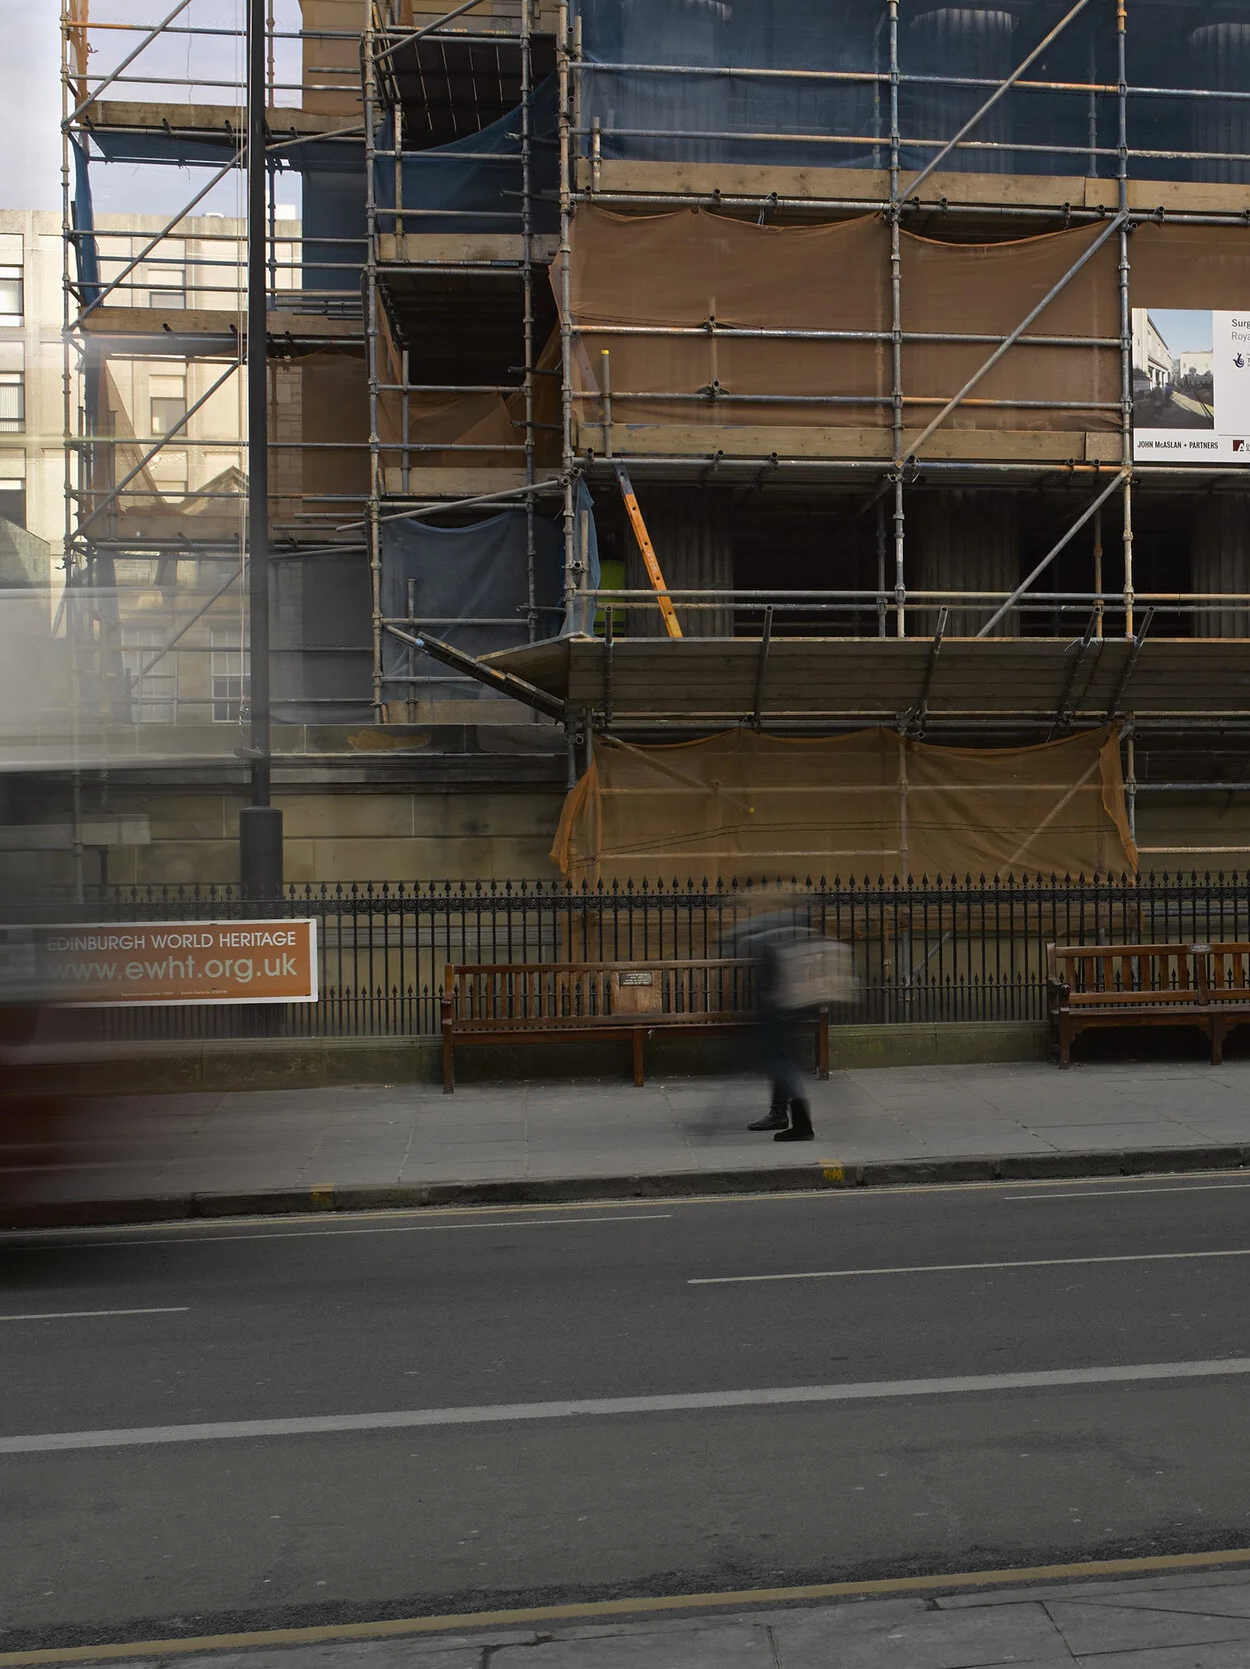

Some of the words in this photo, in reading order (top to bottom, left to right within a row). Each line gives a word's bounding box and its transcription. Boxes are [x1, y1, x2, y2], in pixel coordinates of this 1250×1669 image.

[1154, 441, 1182, 449] McASLAN
[1189, 441, 1218, 449] PARTNERS
[47, 935, 145, 951] EDINBURGH
[150, 933, 213, 949] WORLD
[219, 931, 296, 947] HERITAGE
